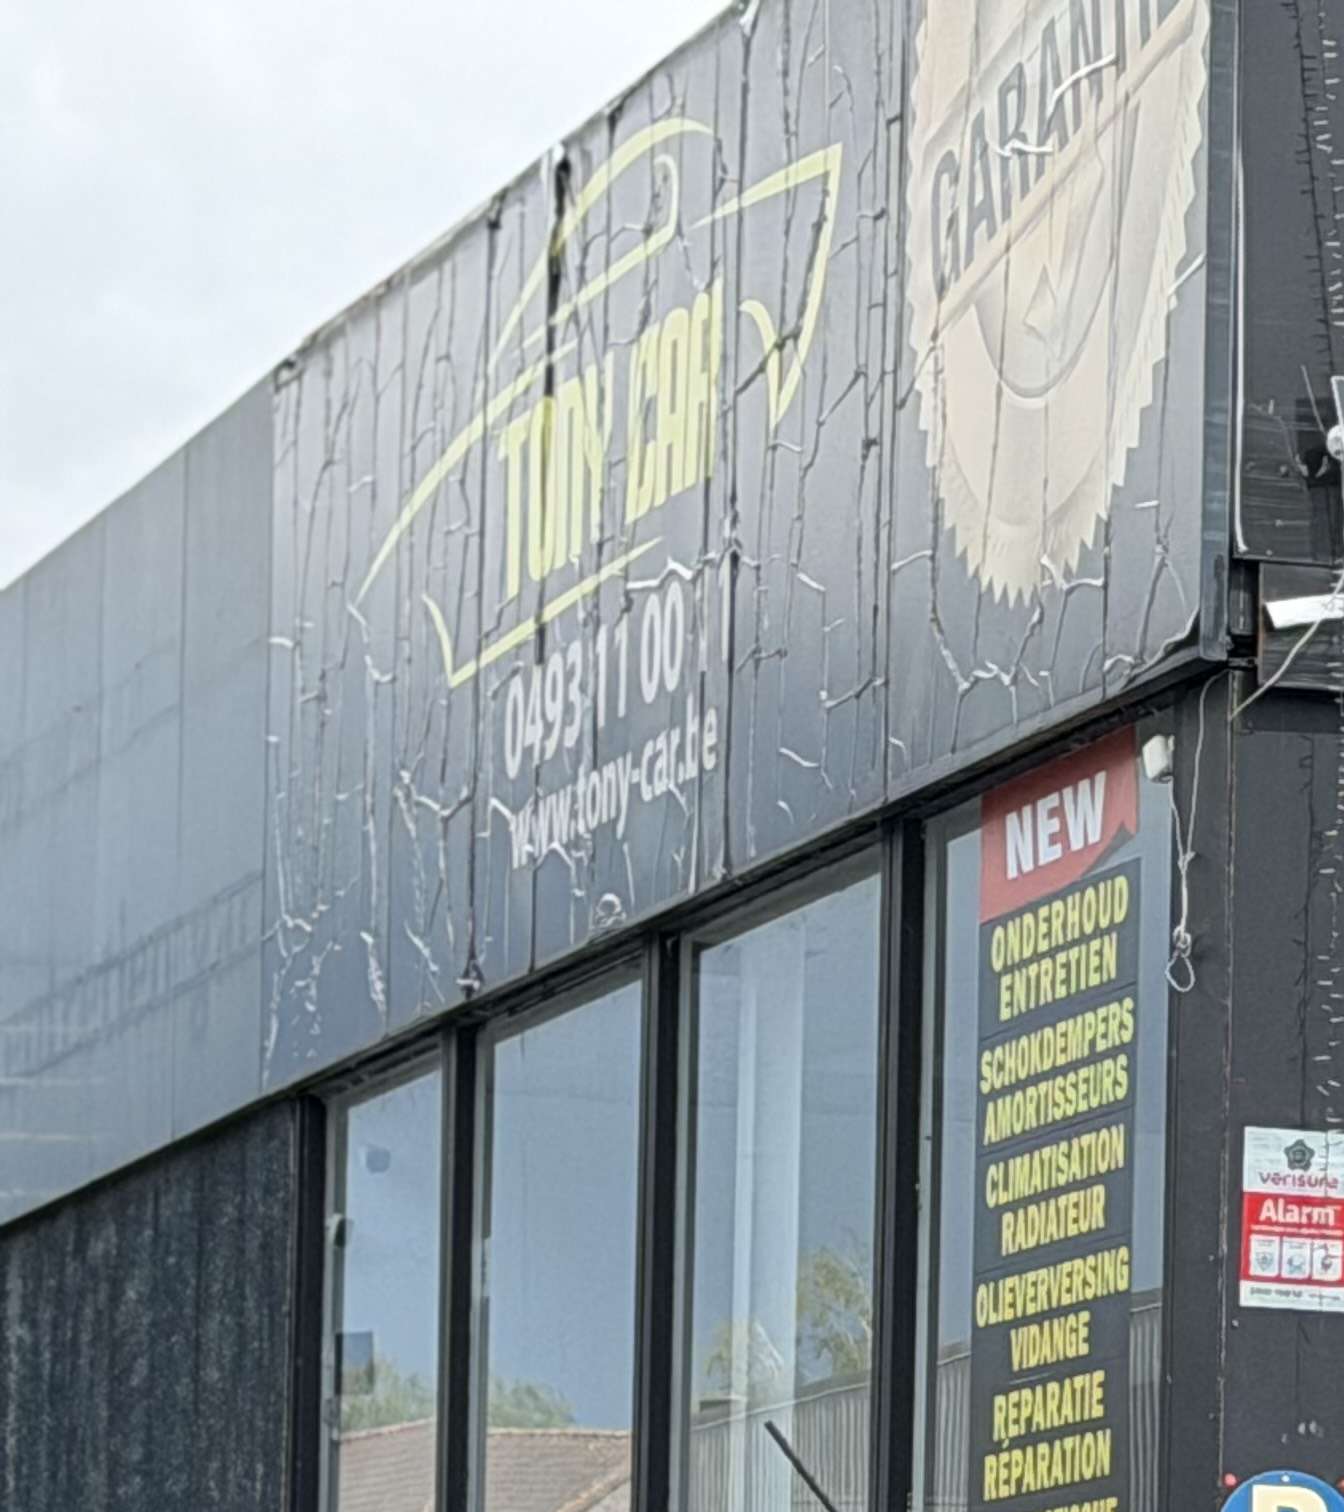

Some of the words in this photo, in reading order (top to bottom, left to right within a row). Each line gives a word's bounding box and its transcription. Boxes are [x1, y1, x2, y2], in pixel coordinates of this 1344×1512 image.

[931, 0, 1182, 303] GARAN
[497, 350, 614, 600] TONY
[624, 276, 724, 526] CAR
[505, 640, 583, 780] 0493
[596, 610, 628, 728] 11
[641, 581, 685, 704] 00
[510, 692, 718, 869] www.tony-car.be
[1006, 771, 1107, 880] NEW
[991, 875, 1129, 972] ONDERHOUD
[1000, 932, 1117, 1021] ENTRETIEN
[980, 997, 1135, 1094] SCHOKDEMPERS
[984, 1054, 1128, 1146] AMORTISSEURS
[986, 1124, 1125, 1208] CLIMATISATION
[1259, 1171, 1340, 1189] verisure
[1002, 1184, 1106, 1256] RADIATEUR
[1259, 1198, 1337, 1226] Alarm
[976, 1246, 1130, 1328] OLIEVERVERSING
[1010, 1311, 1090, 1372] VIDANGE
[993, 1369, 1105, 1441] REPARATIE
